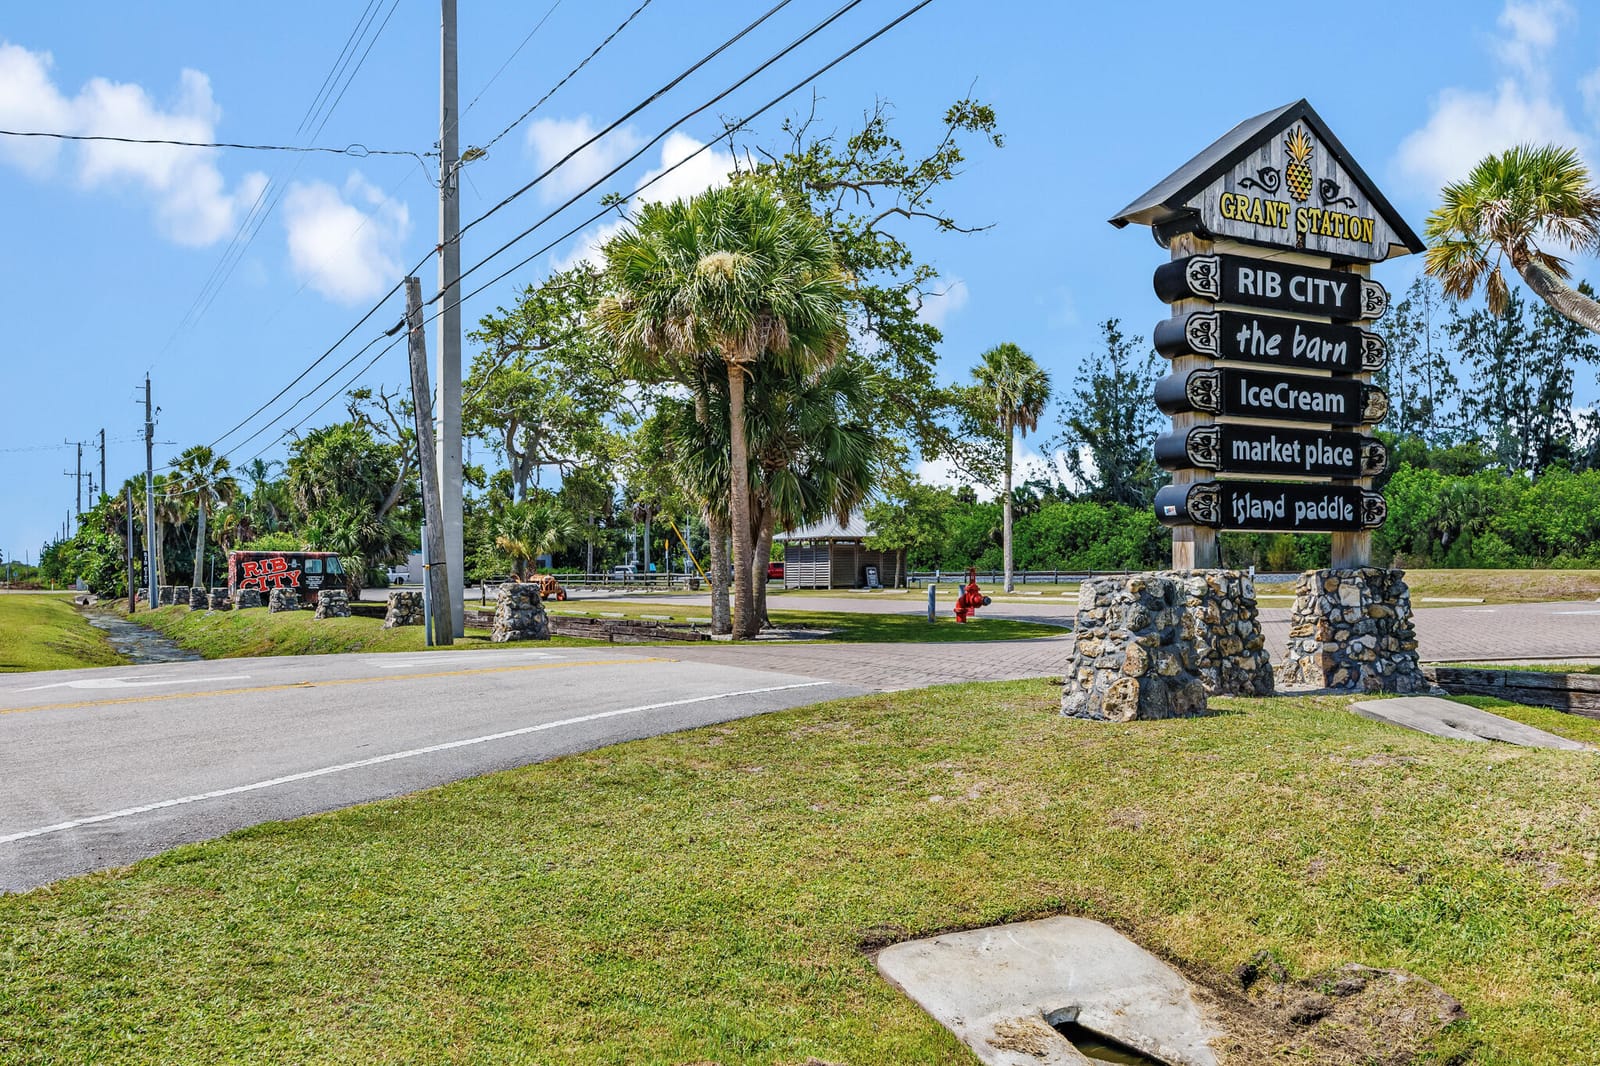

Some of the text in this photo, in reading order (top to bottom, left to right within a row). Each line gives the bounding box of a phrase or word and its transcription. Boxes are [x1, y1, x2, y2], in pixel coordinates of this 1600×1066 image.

[1220, 192, 1374, 243] GRANT STATION
[1238, 267, 1347, 307] RIB CITY
[1236, 320, 1347, 365] the barn
[1240, 379, 1345, 413] IceCream
[1232, 435, 1353, 470] market place
[1232, 492, 1353, 525] island paddle
[240, 569, 301, 593] CITY
[241, 557, 288, 578] RIB
